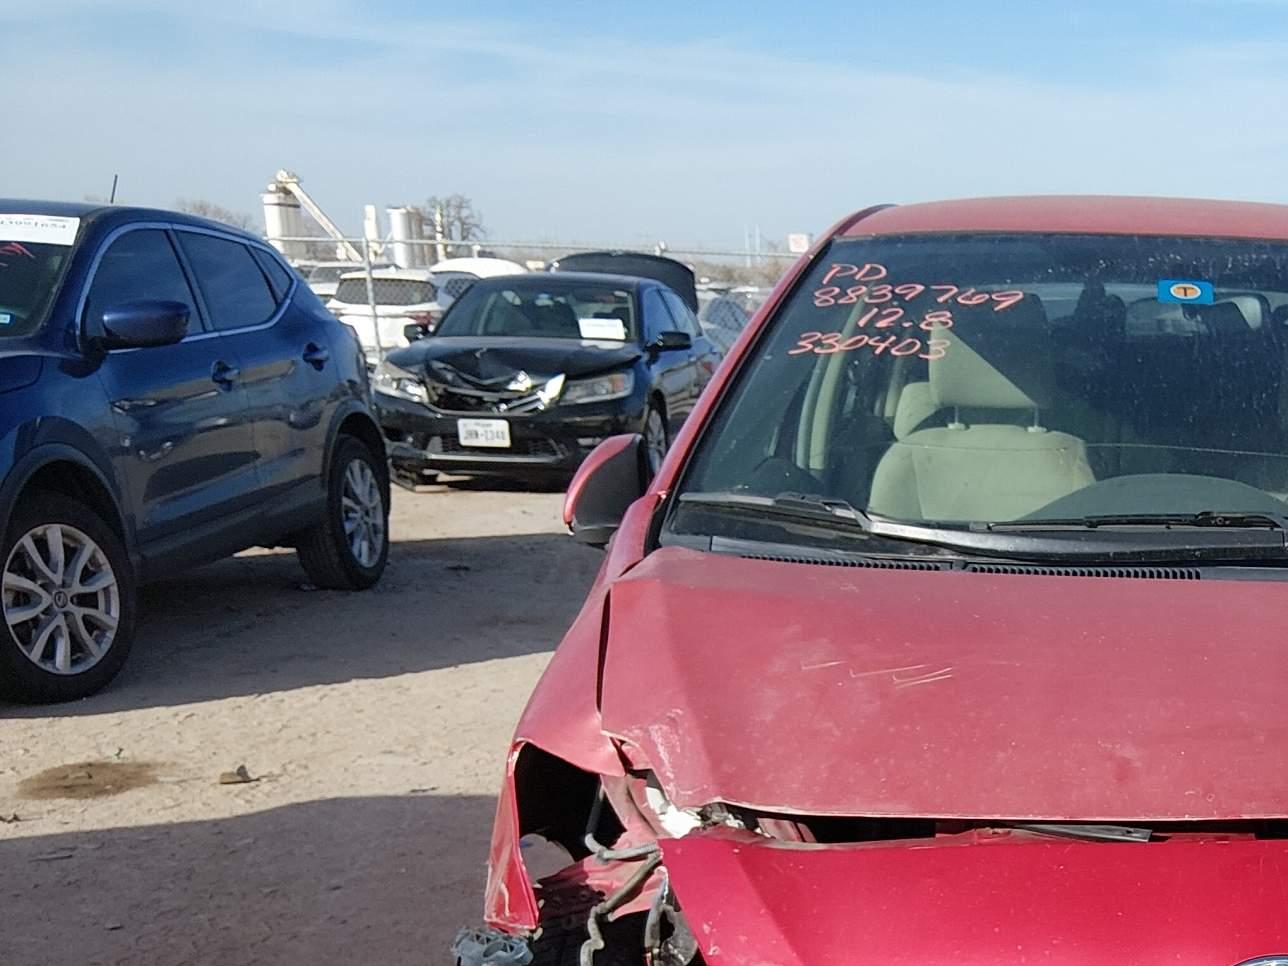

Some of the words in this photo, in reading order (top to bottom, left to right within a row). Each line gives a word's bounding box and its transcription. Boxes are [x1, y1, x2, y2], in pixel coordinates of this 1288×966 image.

[822, 263, 888, 285] PD
[813, 284, 1025, 312] 8839769
[857, 307, 954, 330] 12.8
[788, 331, 951, 360] 330403
